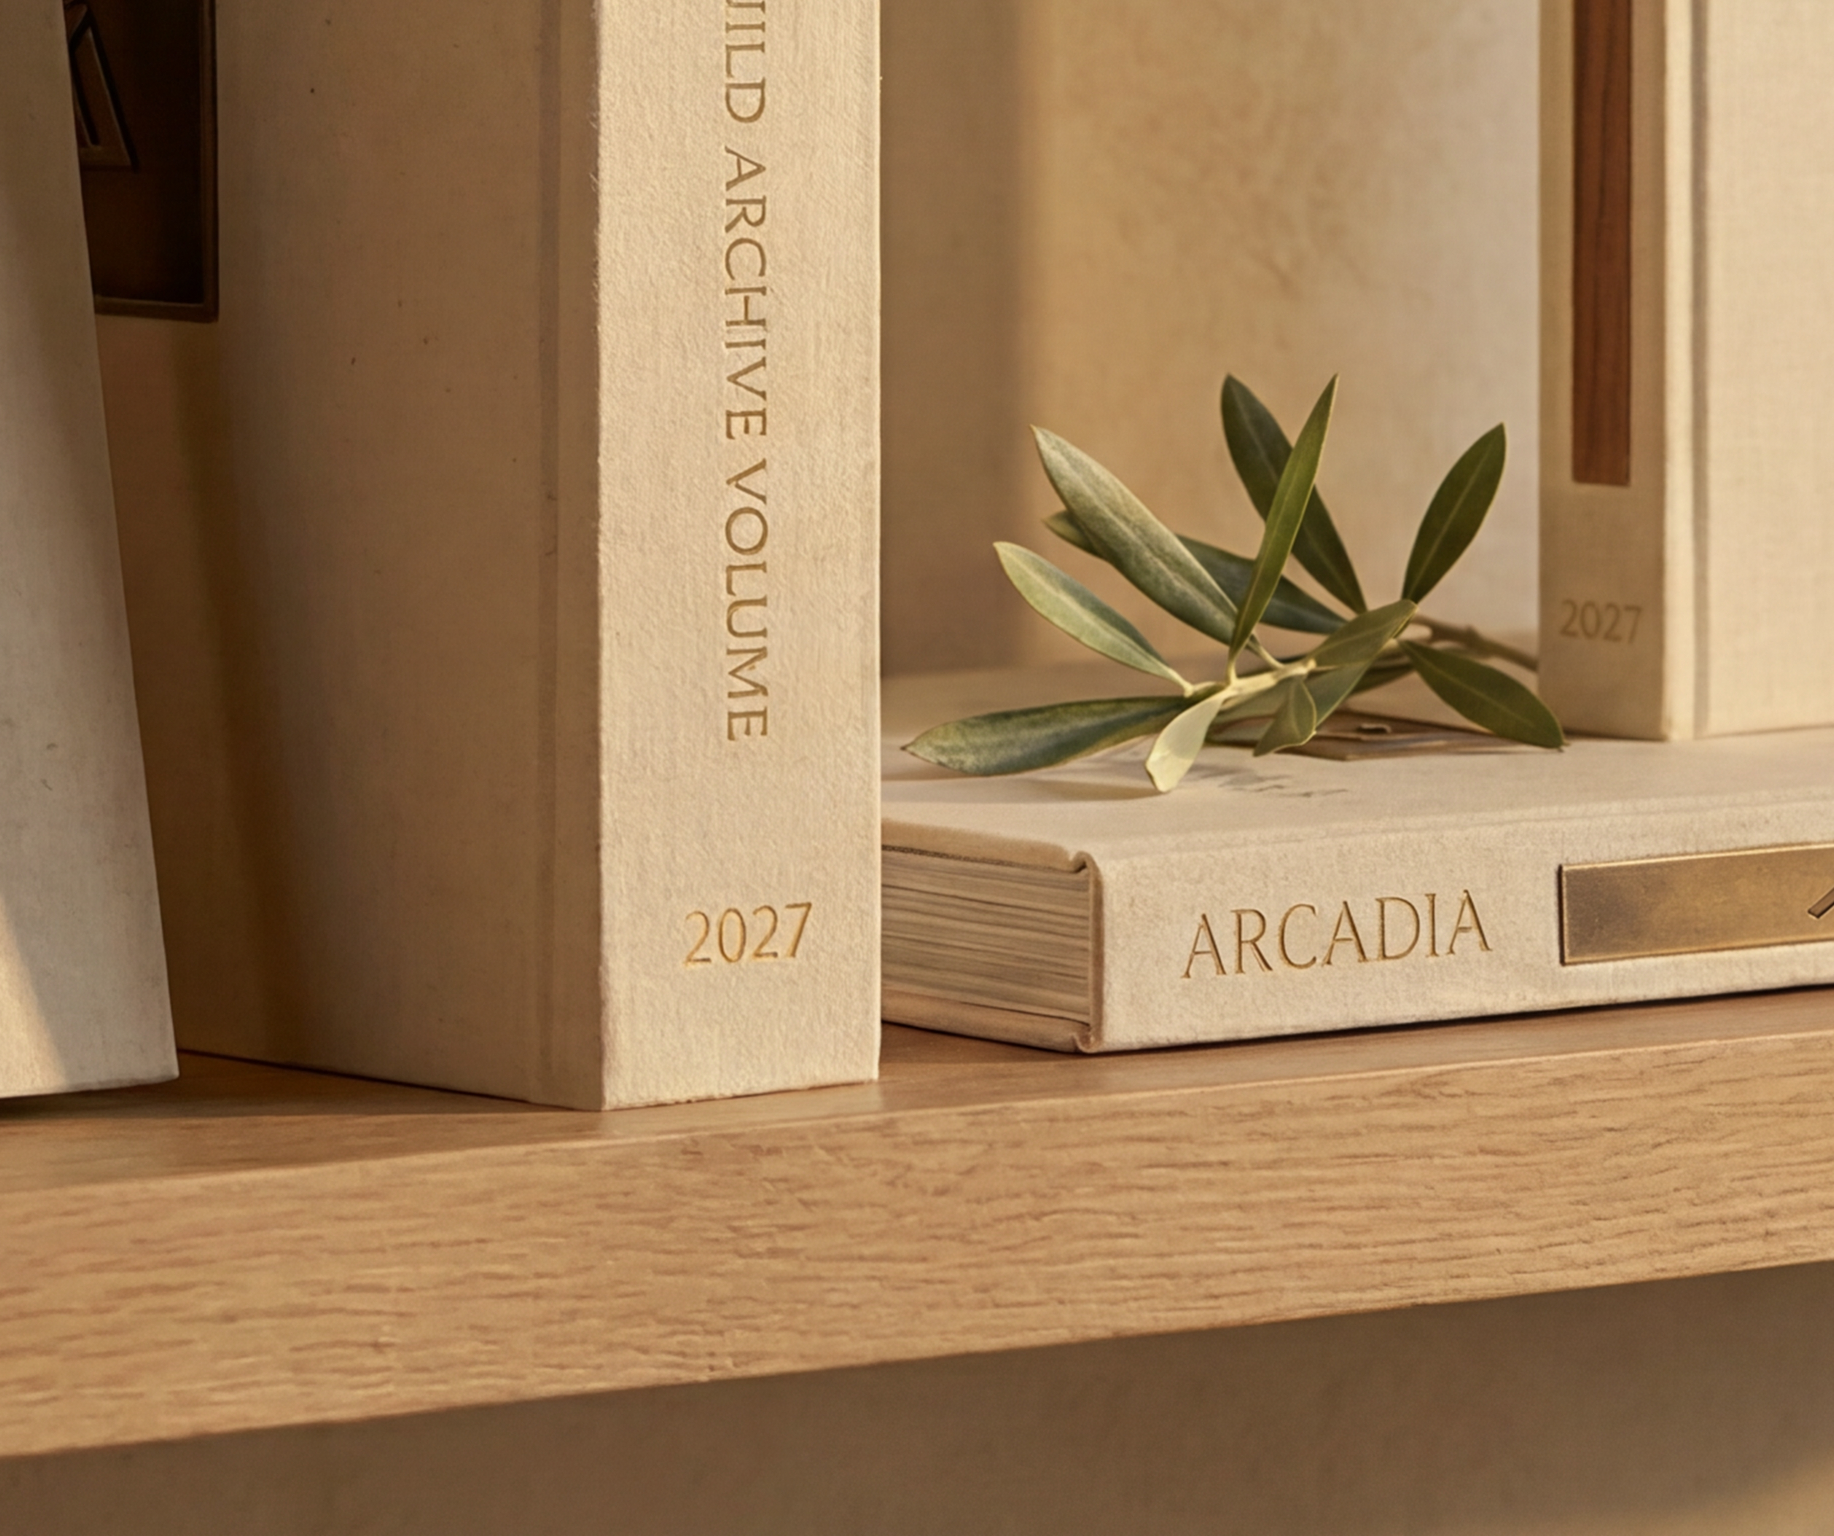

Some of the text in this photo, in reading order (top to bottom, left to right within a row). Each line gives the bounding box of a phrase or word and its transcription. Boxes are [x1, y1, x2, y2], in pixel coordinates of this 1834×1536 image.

[724, 146, 767, 440] ARCHIVE
[725, 458, 768, 742] VOLUME
[1559, 599, 1643, 644] 2027
[683, 901, 813, 965] 2027
[1181, 889, 1493, 980] ARCADIA
